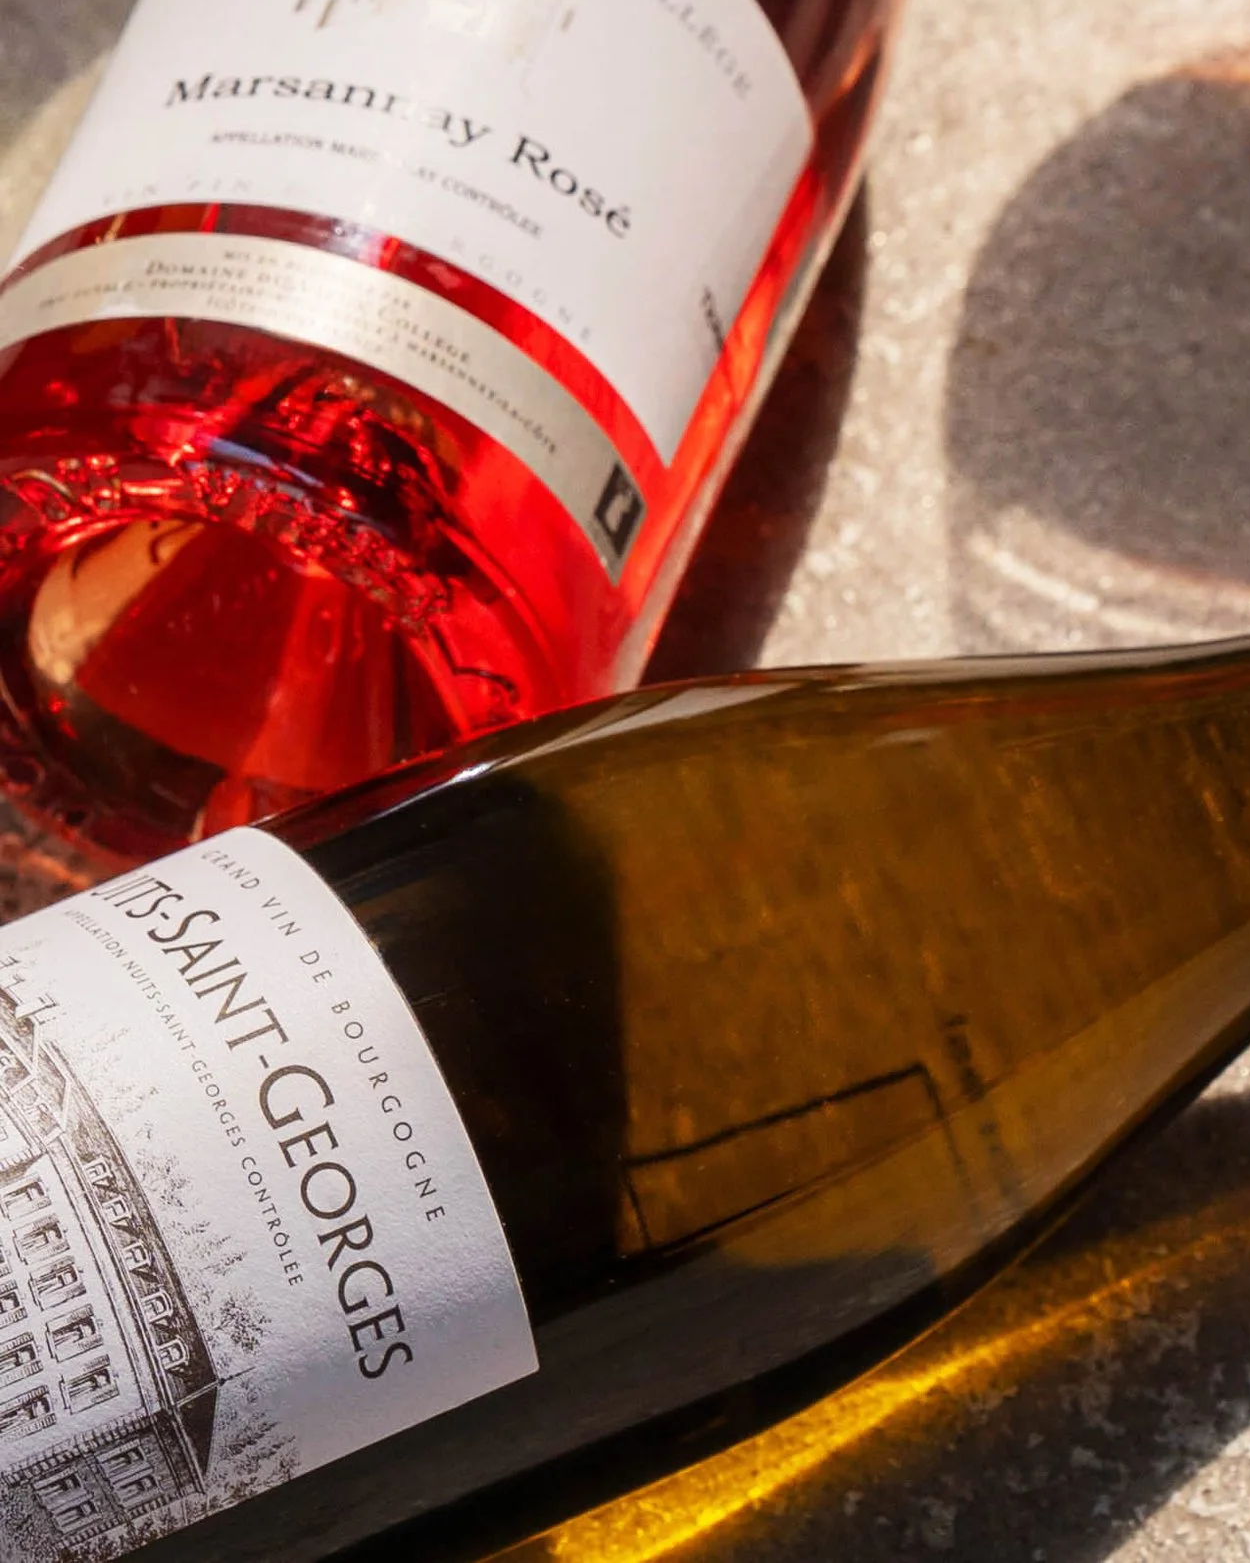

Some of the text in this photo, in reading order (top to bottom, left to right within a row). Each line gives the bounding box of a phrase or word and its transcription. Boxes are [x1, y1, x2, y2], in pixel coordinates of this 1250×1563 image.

[508, 132, 632, 241] Rosé
[64, 908, 127, 959] APPELLATION
[122, 959, 247, 1149] NUITS-SAINT-GEORGES
[201, 848, 447, 1222] GRAND VIN DE BOURGOGNE
